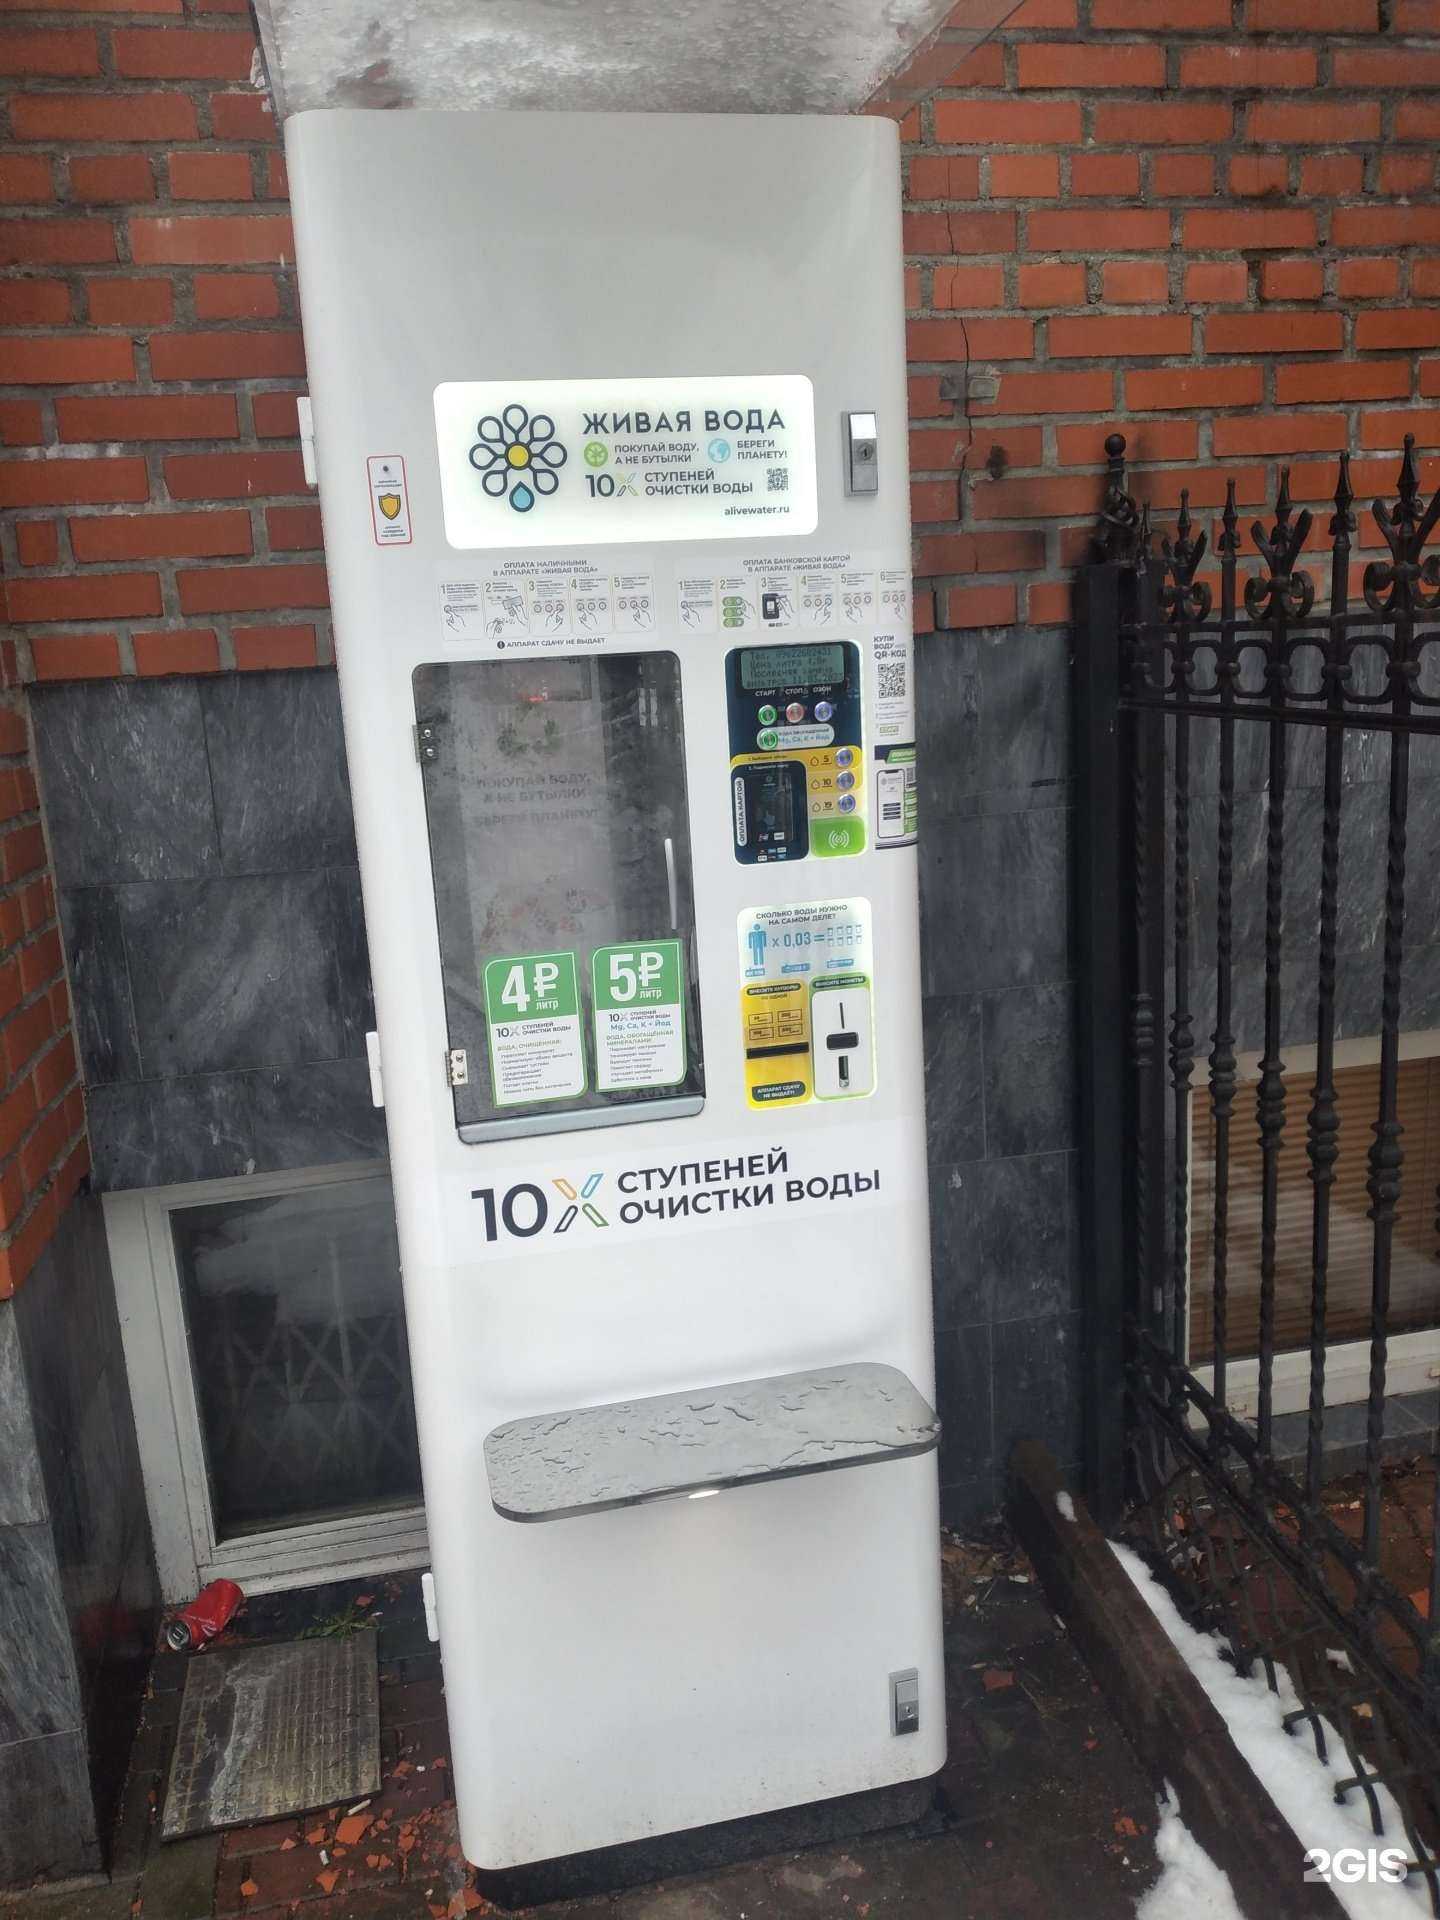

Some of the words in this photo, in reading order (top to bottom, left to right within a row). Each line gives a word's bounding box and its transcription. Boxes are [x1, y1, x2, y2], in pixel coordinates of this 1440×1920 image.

[582, 410, 691, 435] ЖИВАЯ
[704, 408, 786, 434] ВОДА
[614, 442, 666, 453] ПОКУПАЙ
[668, 442, 700, 453] ВОДУ,
[737, 439, 775, 448] БЕРЕГИ
[625, 456, 640, 464] НЕ
[641, 455, 692, 464] БУТЫЛКИ
[737, 450, 788, 459] ПЛАНЕТУ!
[644, 467, 715, 482] СТУПЕНЕЙ
[645, 483, 709, 496] ОЧИСТКИ
[713, 482, 753, 494] ВОДЫ
[724, 506, 790, 516] alivewater.ru
[503, 561, 535, 569] ОПЛАТА
[743, 559, 773, 567] ОПЛАТА
[485, 583, 491, 592] 2
[529, 581, 535, 591] 3
[720, 580, 726, 589] 2
[506, 640, 540, 648] АППАРАТ
[823, 778, 832, 786] 10
[755, 910, 793, 920] СКОЛЬКО
[794, 908, 818, 916] ВОДЫ
[819, 904, 848, 913] НУЖНО
[781, 917, 811, 925] САМОМ
[783, 931, 811, 949] 0,03
[639, 988, 663, 1000] литр
[535, 999, 559, 1011] литр
[616, 1146, 788, 1194] СТУПЕНЕЙ
[618, 1182, 774, 1225] ОЧИСТКИ
[785, 1168, 881, 1203] ВОДЫ
